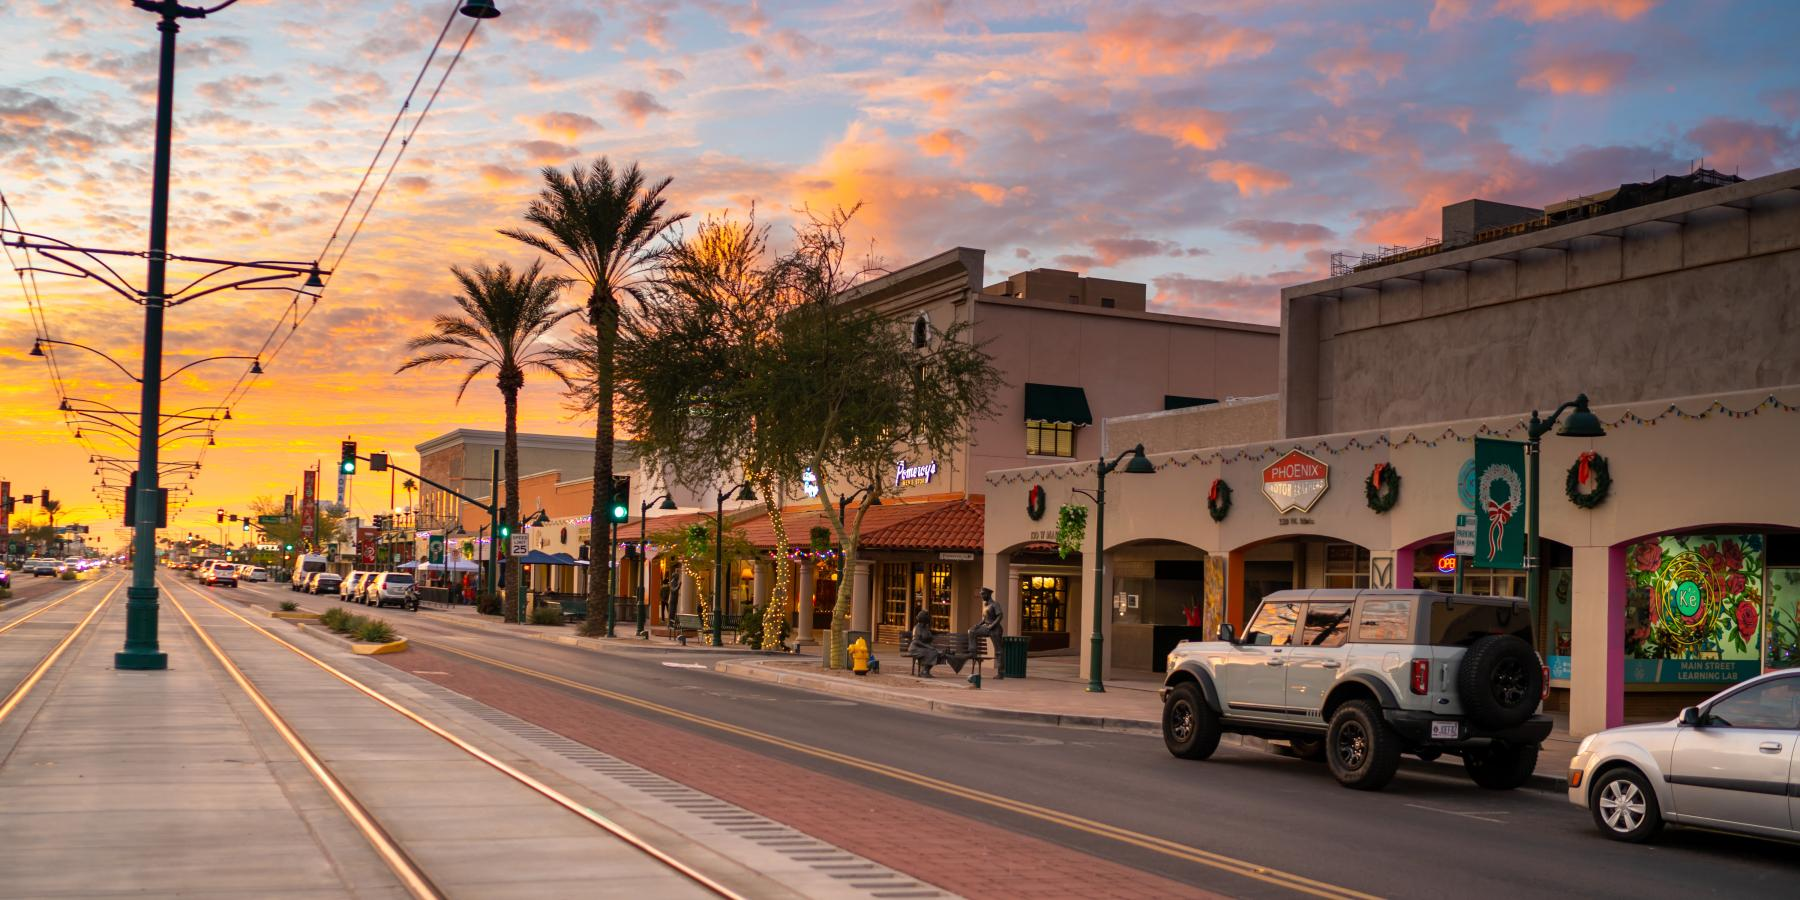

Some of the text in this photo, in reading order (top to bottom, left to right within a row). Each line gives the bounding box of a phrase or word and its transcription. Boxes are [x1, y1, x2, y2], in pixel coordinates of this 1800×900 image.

[896, 459, 936, 487] Pomeroy's
[1271, 463, 1319, 479] PHOENIX
[513, 545, 527, 554] 25
[1681, 662, 1736, 670] MAIN STREET
[1678, 672, 1738, 680] LEARNING LAB
